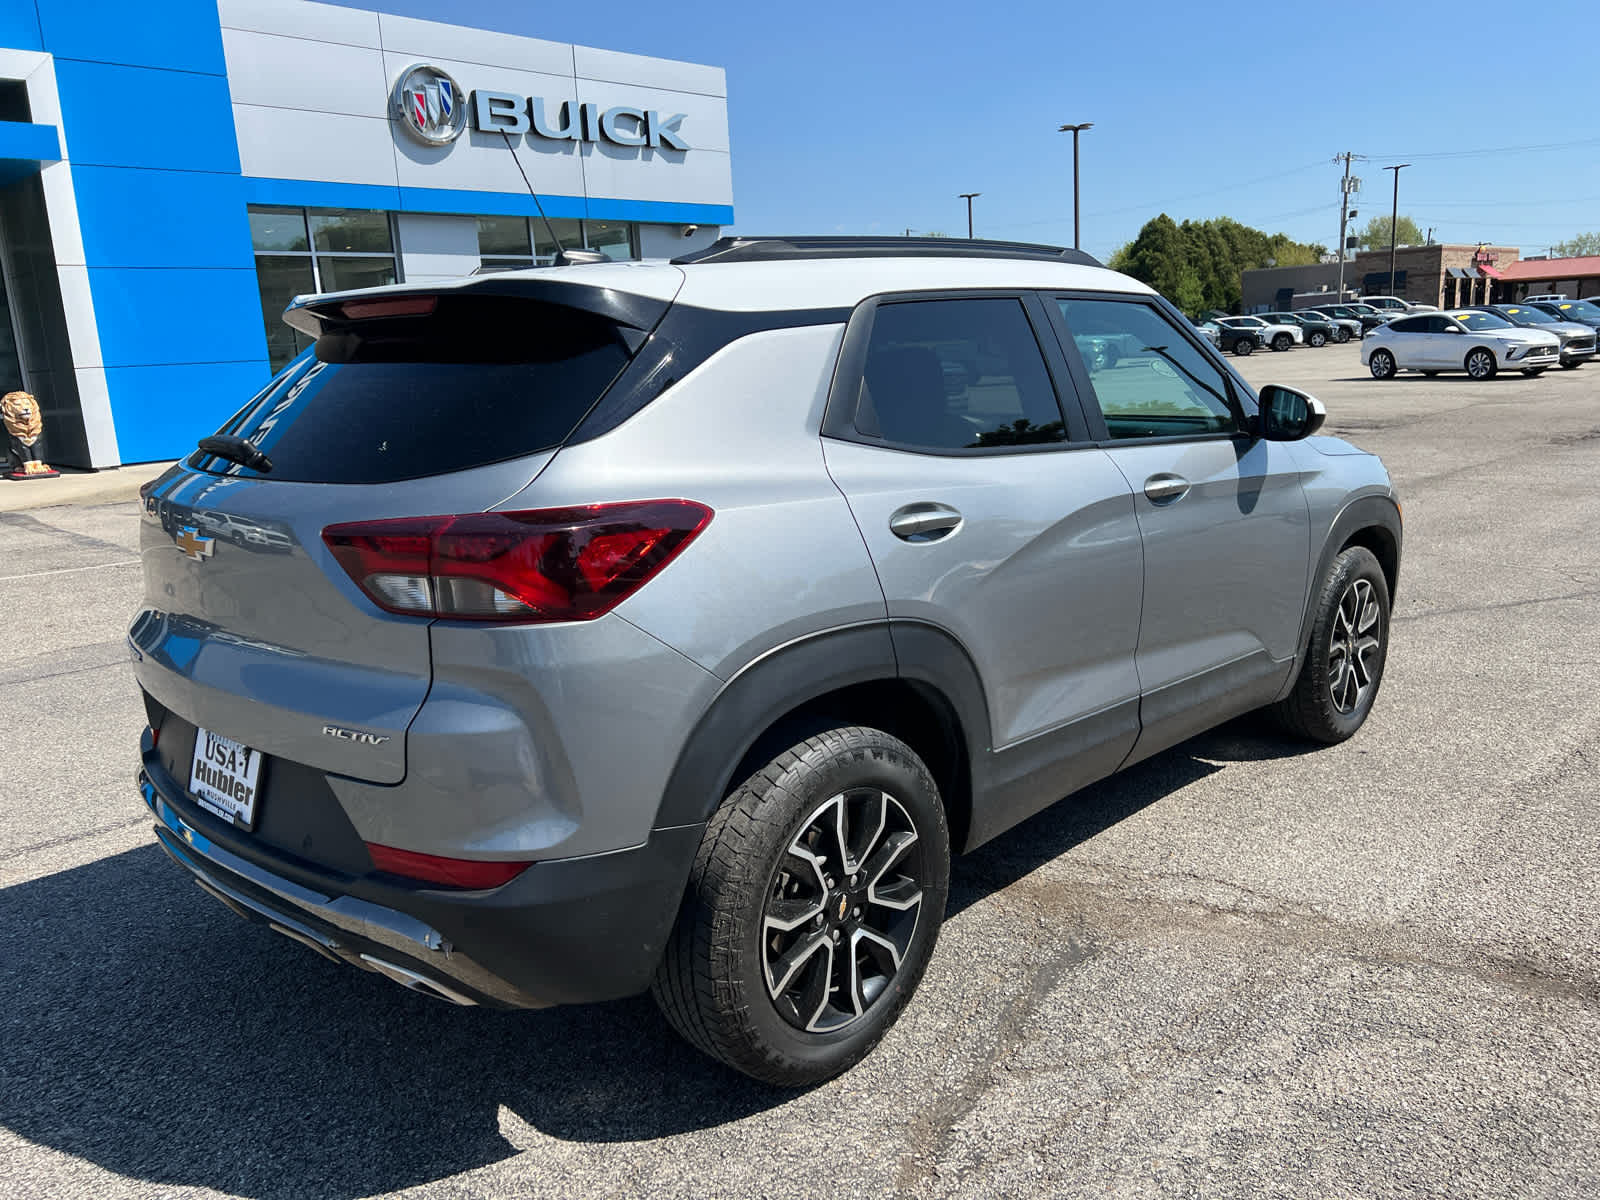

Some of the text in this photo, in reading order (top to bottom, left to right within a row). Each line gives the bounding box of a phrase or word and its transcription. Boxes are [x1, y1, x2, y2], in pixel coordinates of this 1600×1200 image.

[469, 89, 690, 151] BUICK
[322, 725, 390, 745] ACTIV
[195, 758, 253, 806] Hubler
